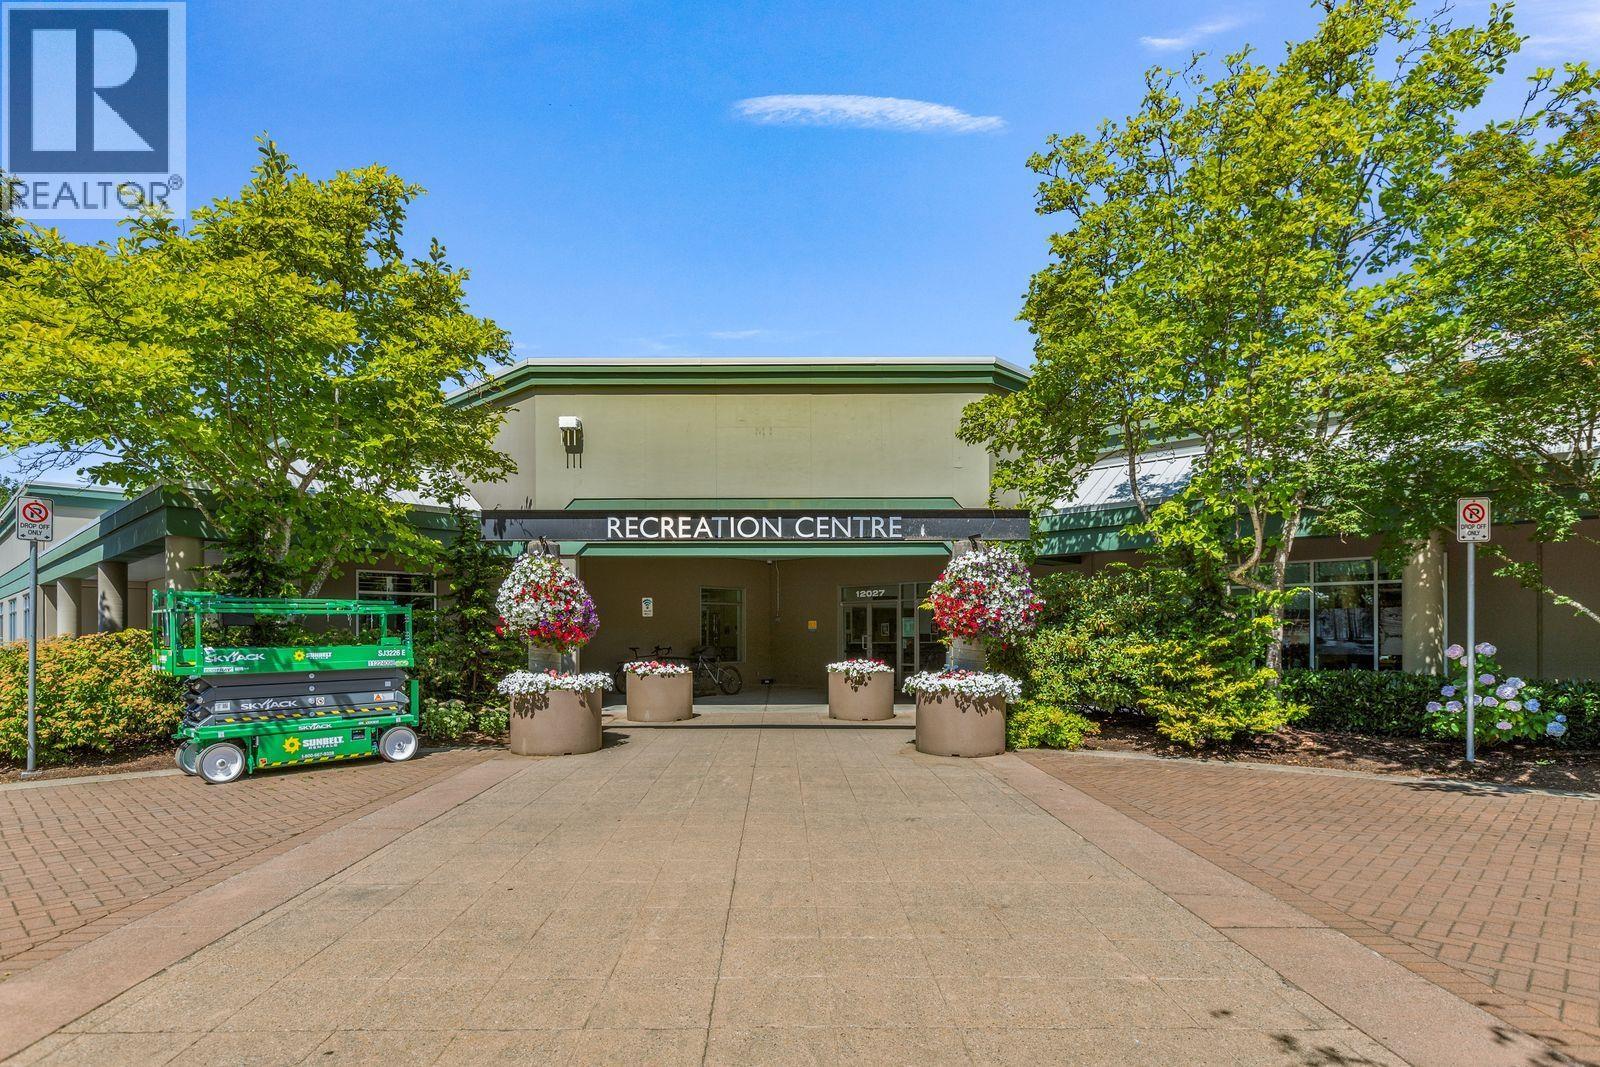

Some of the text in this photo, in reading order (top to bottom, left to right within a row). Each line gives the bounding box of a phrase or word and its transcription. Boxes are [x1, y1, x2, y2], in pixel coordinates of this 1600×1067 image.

[606, 516, 903, 539] RECREATION CENTRE
[855, 589, 885, 598] 12027
[205, 651, 266, 663] SKYJACK
[240, 698, 299, 711] SKYJACK
[298, 722, 332, 731] SKYJACK
[302, 736, 344, 748] SUNBELT
